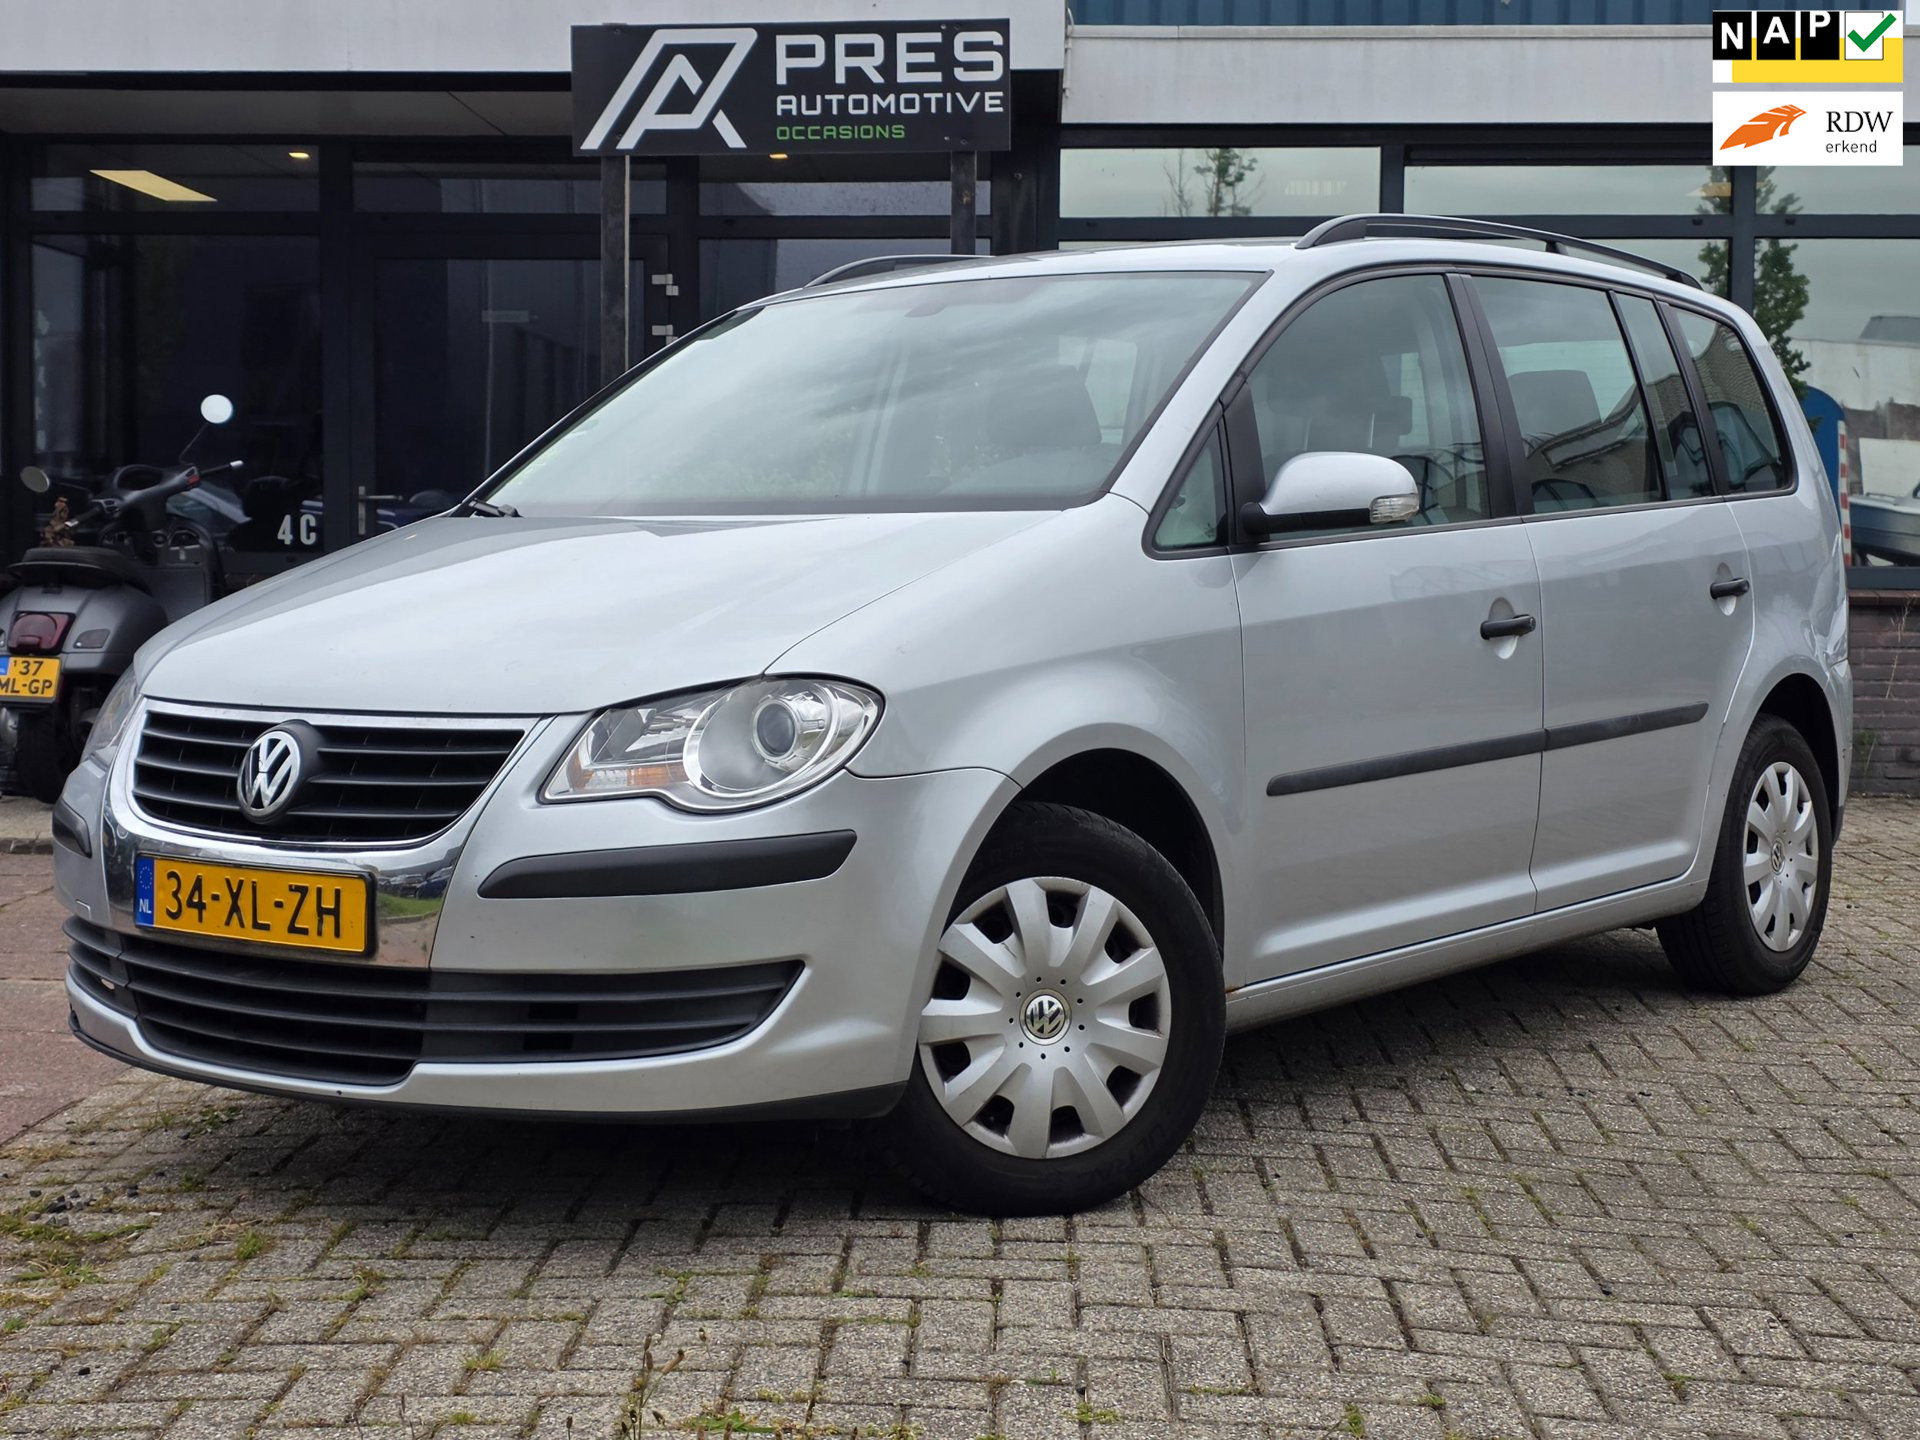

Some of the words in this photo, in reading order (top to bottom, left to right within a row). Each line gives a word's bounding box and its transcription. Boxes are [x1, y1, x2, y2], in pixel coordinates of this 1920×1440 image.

[775, 30, 1004, 86] PRES
[775, 91, 1005, 117] AUTOMOTIVE
[775, 124, 906, 141] OCCASIONS
[139, 898, 152, 915] NL
[165, 869, 342, 939] 34-XL-ZH
